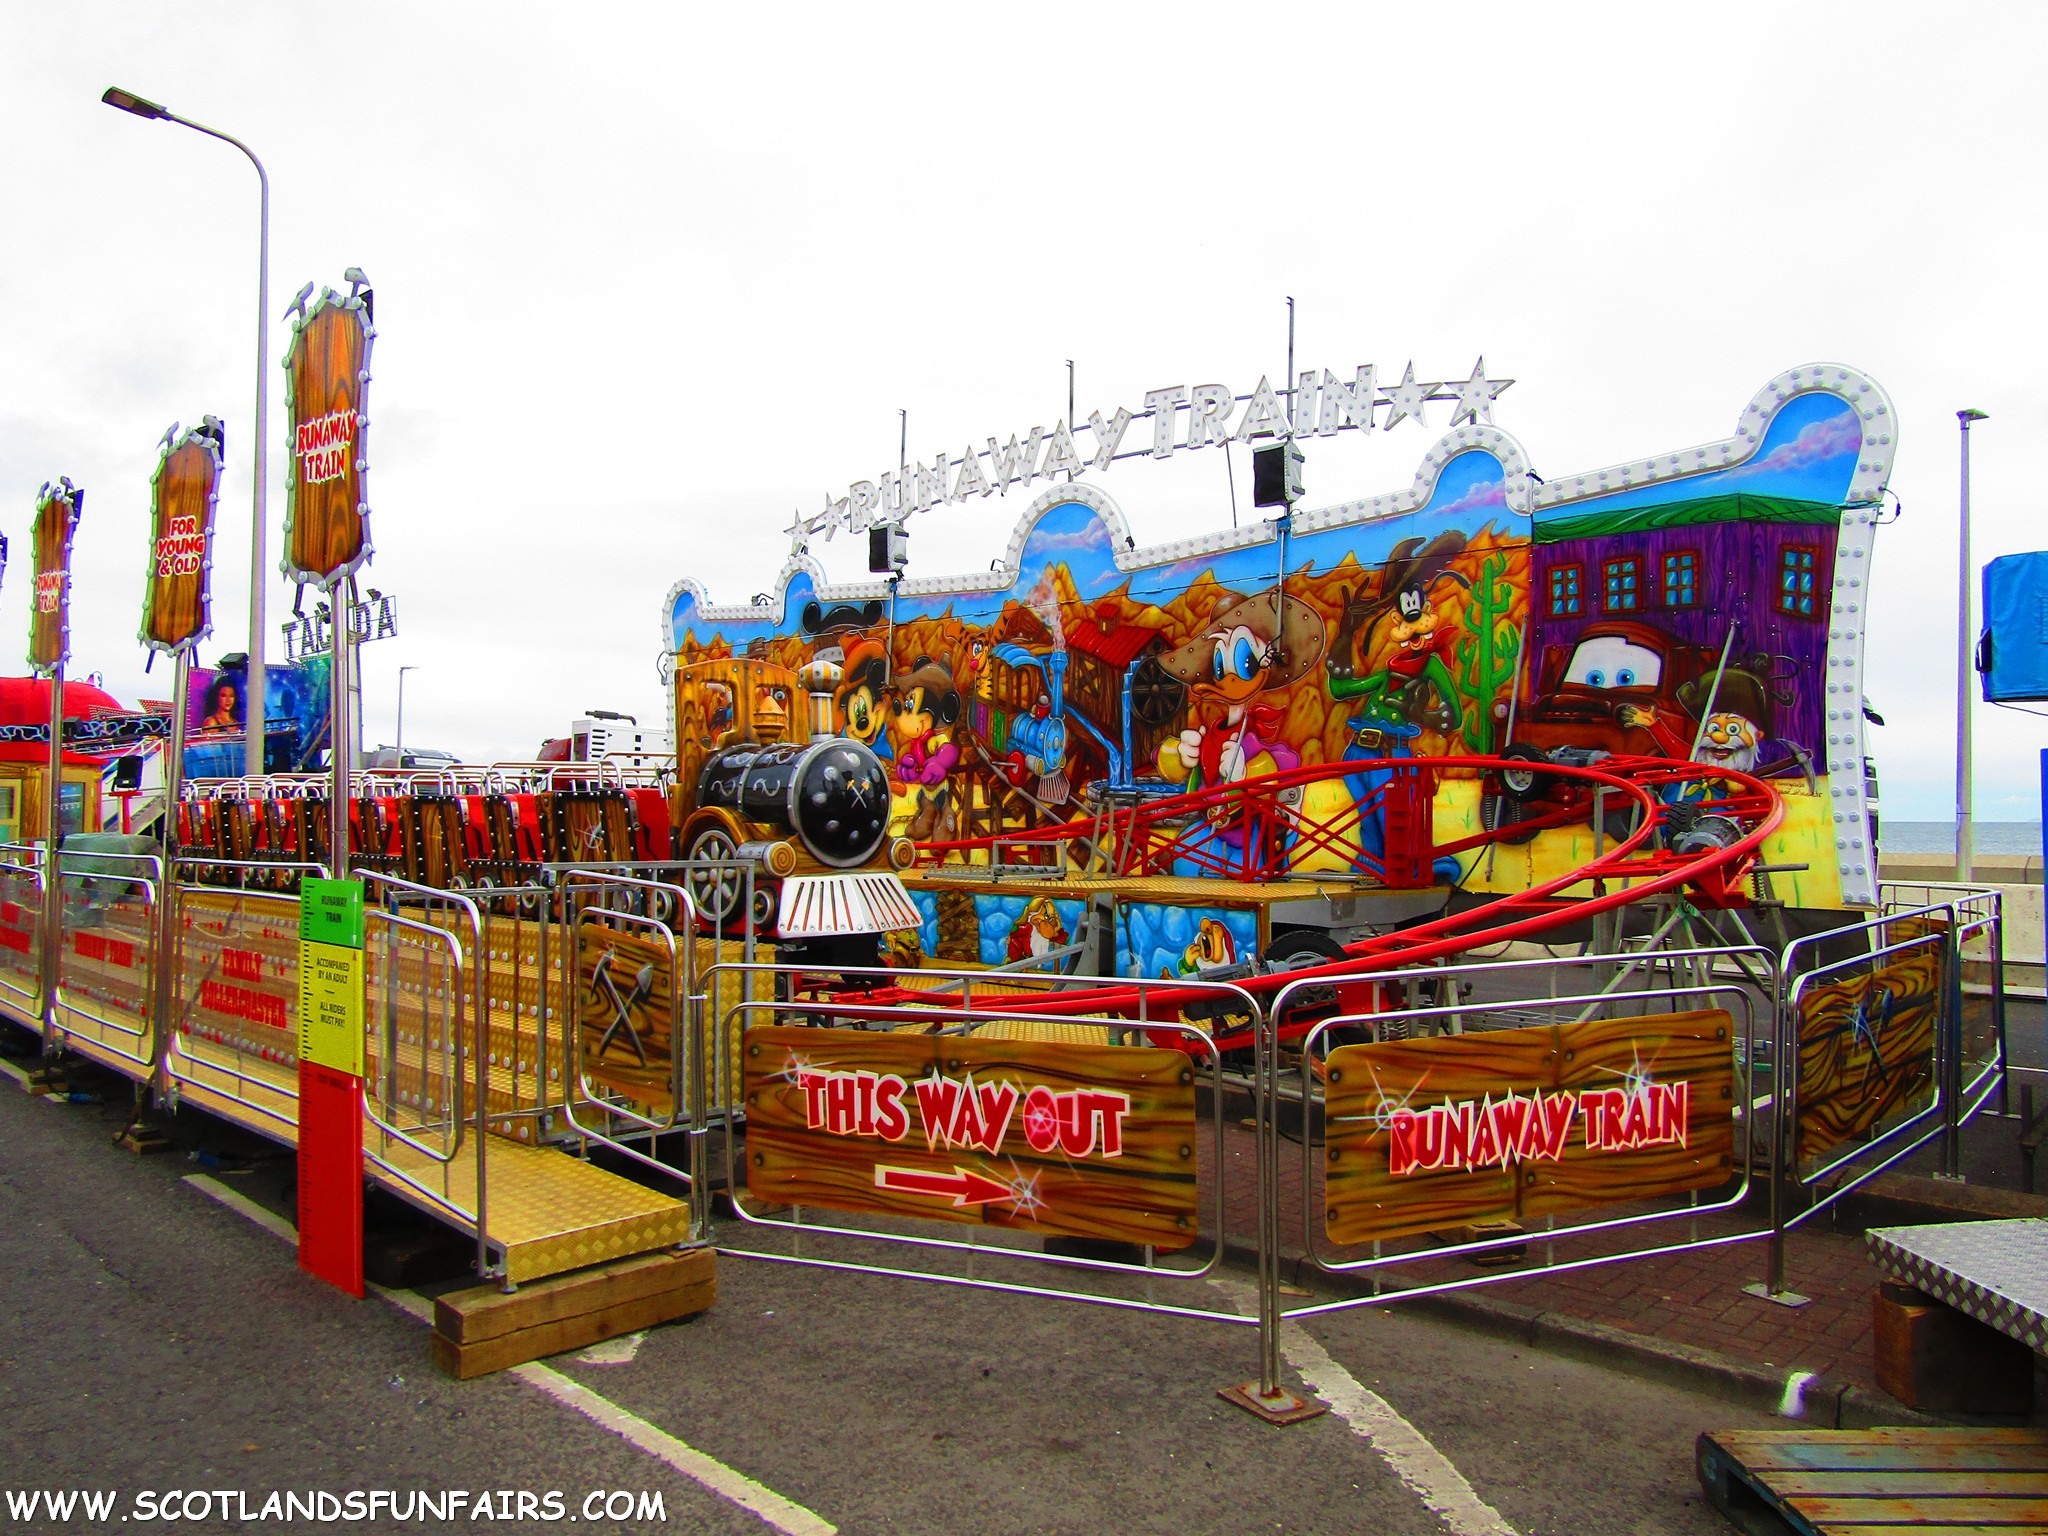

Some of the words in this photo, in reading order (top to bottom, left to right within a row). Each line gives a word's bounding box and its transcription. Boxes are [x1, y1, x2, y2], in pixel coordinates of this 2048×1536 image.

[296, 408, 357, 456] RUNAWAY
[850, 405, 1133, 533] RUNAWAY
[1144, 362, 1378, 460] TRAIN
[305, 446, 345, 483] TRAIN
[170, 515, 197, 537] FOR
[156, 534, 206, 559] YOUNG
[159, 559, 172, 577] &
[172, 556, 200, 575] OLD
[321, 895, 347, 907] RUNAWAY
[326, 911, 342, 923] TRAIN
[317, 957, 350, 972] ACCOMPANIED
[318, 969, 325, 980] BY
[325, 971, 333, 981] AN
[333, 973, 348, 984] ADULT
[320, 1001, 330, 1013] ALL
[330, 1003, 346, 1016] RIDERS
[320, 1014, 333, 1025] MUST
[799, 1067, 911, 1142] THIS
[913, 1067, 1019, 1156] WAY
[1023, 1085, 1130, 1159] OUT
[1389, 1087, 1577, 1175] RUNAWAY
[1578, 1080, 1688, 1151] TRAIN
